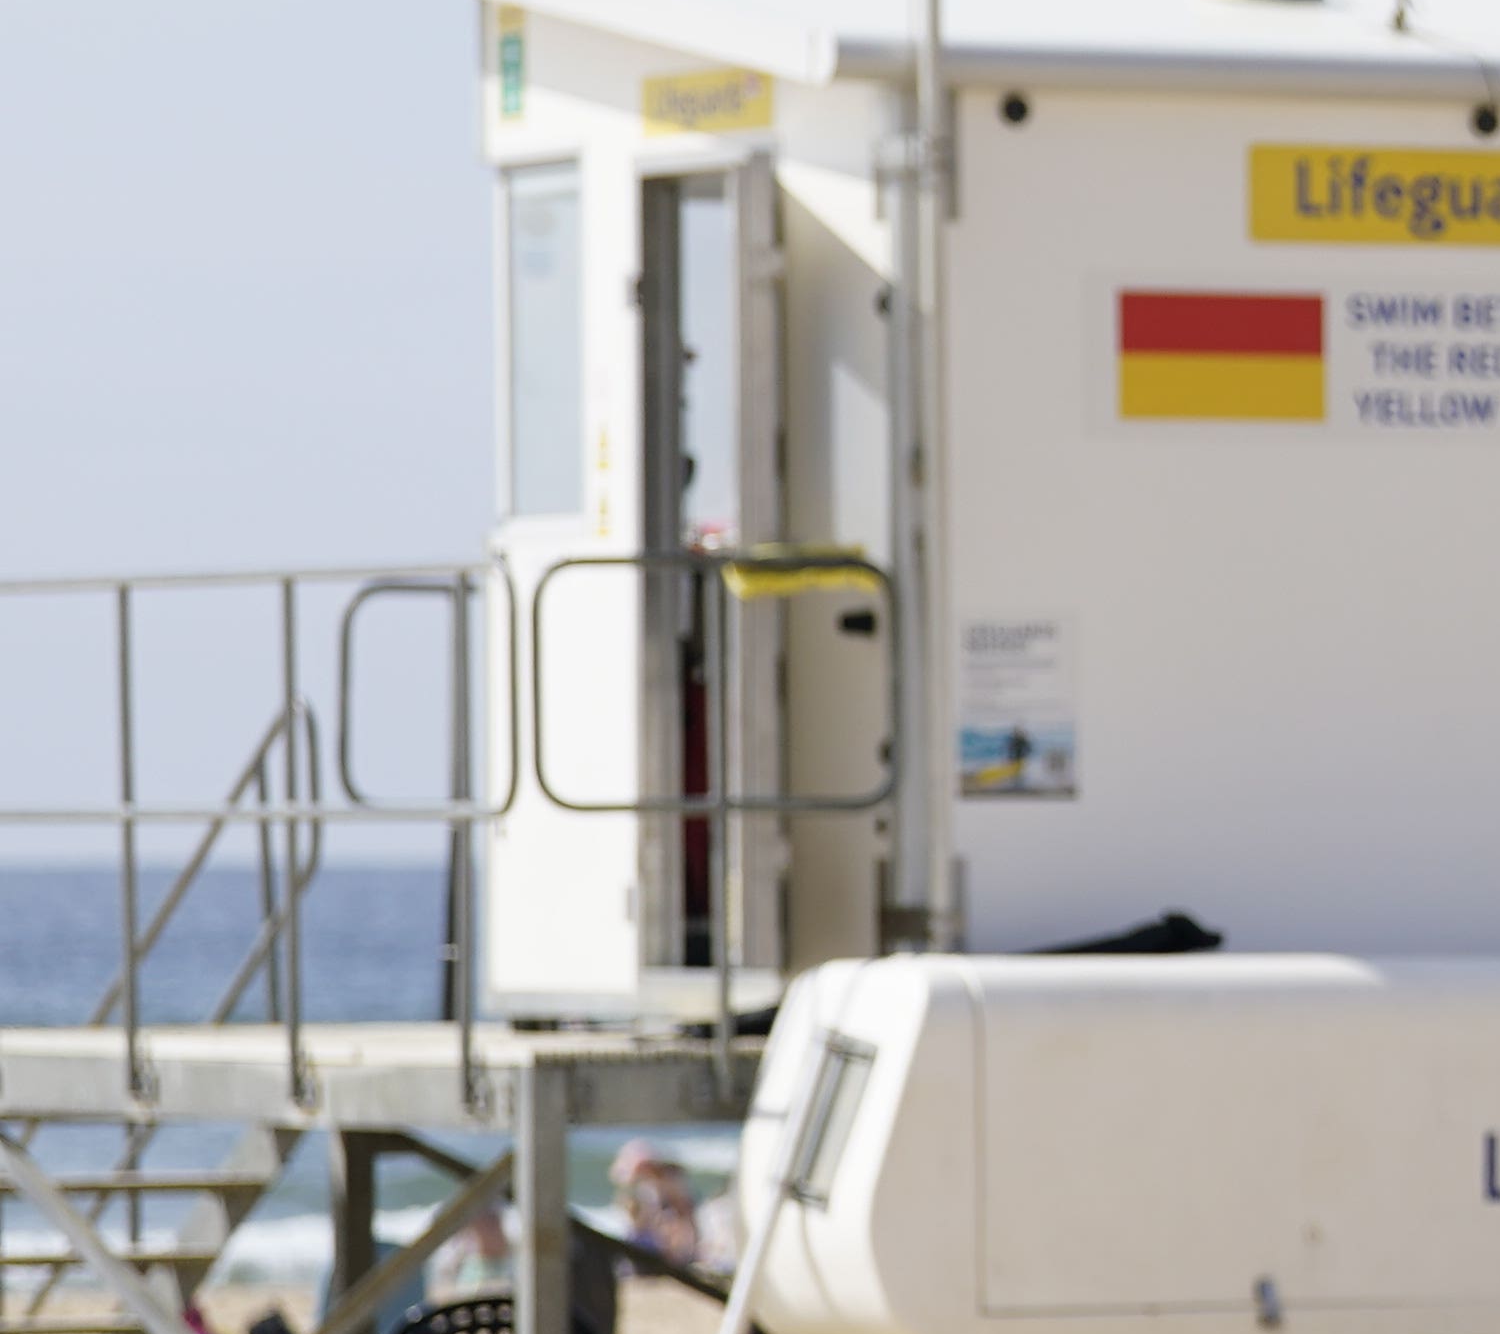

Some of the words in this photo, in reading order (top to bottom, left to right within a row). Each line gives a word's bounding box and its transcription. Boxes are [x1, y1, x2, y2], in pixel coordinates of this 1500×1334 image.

[1349, 295, 1442, 329] SWIM
[1371, 342, 1438, 377] THE
[1354, 391, 1495, 426] YELLOW
